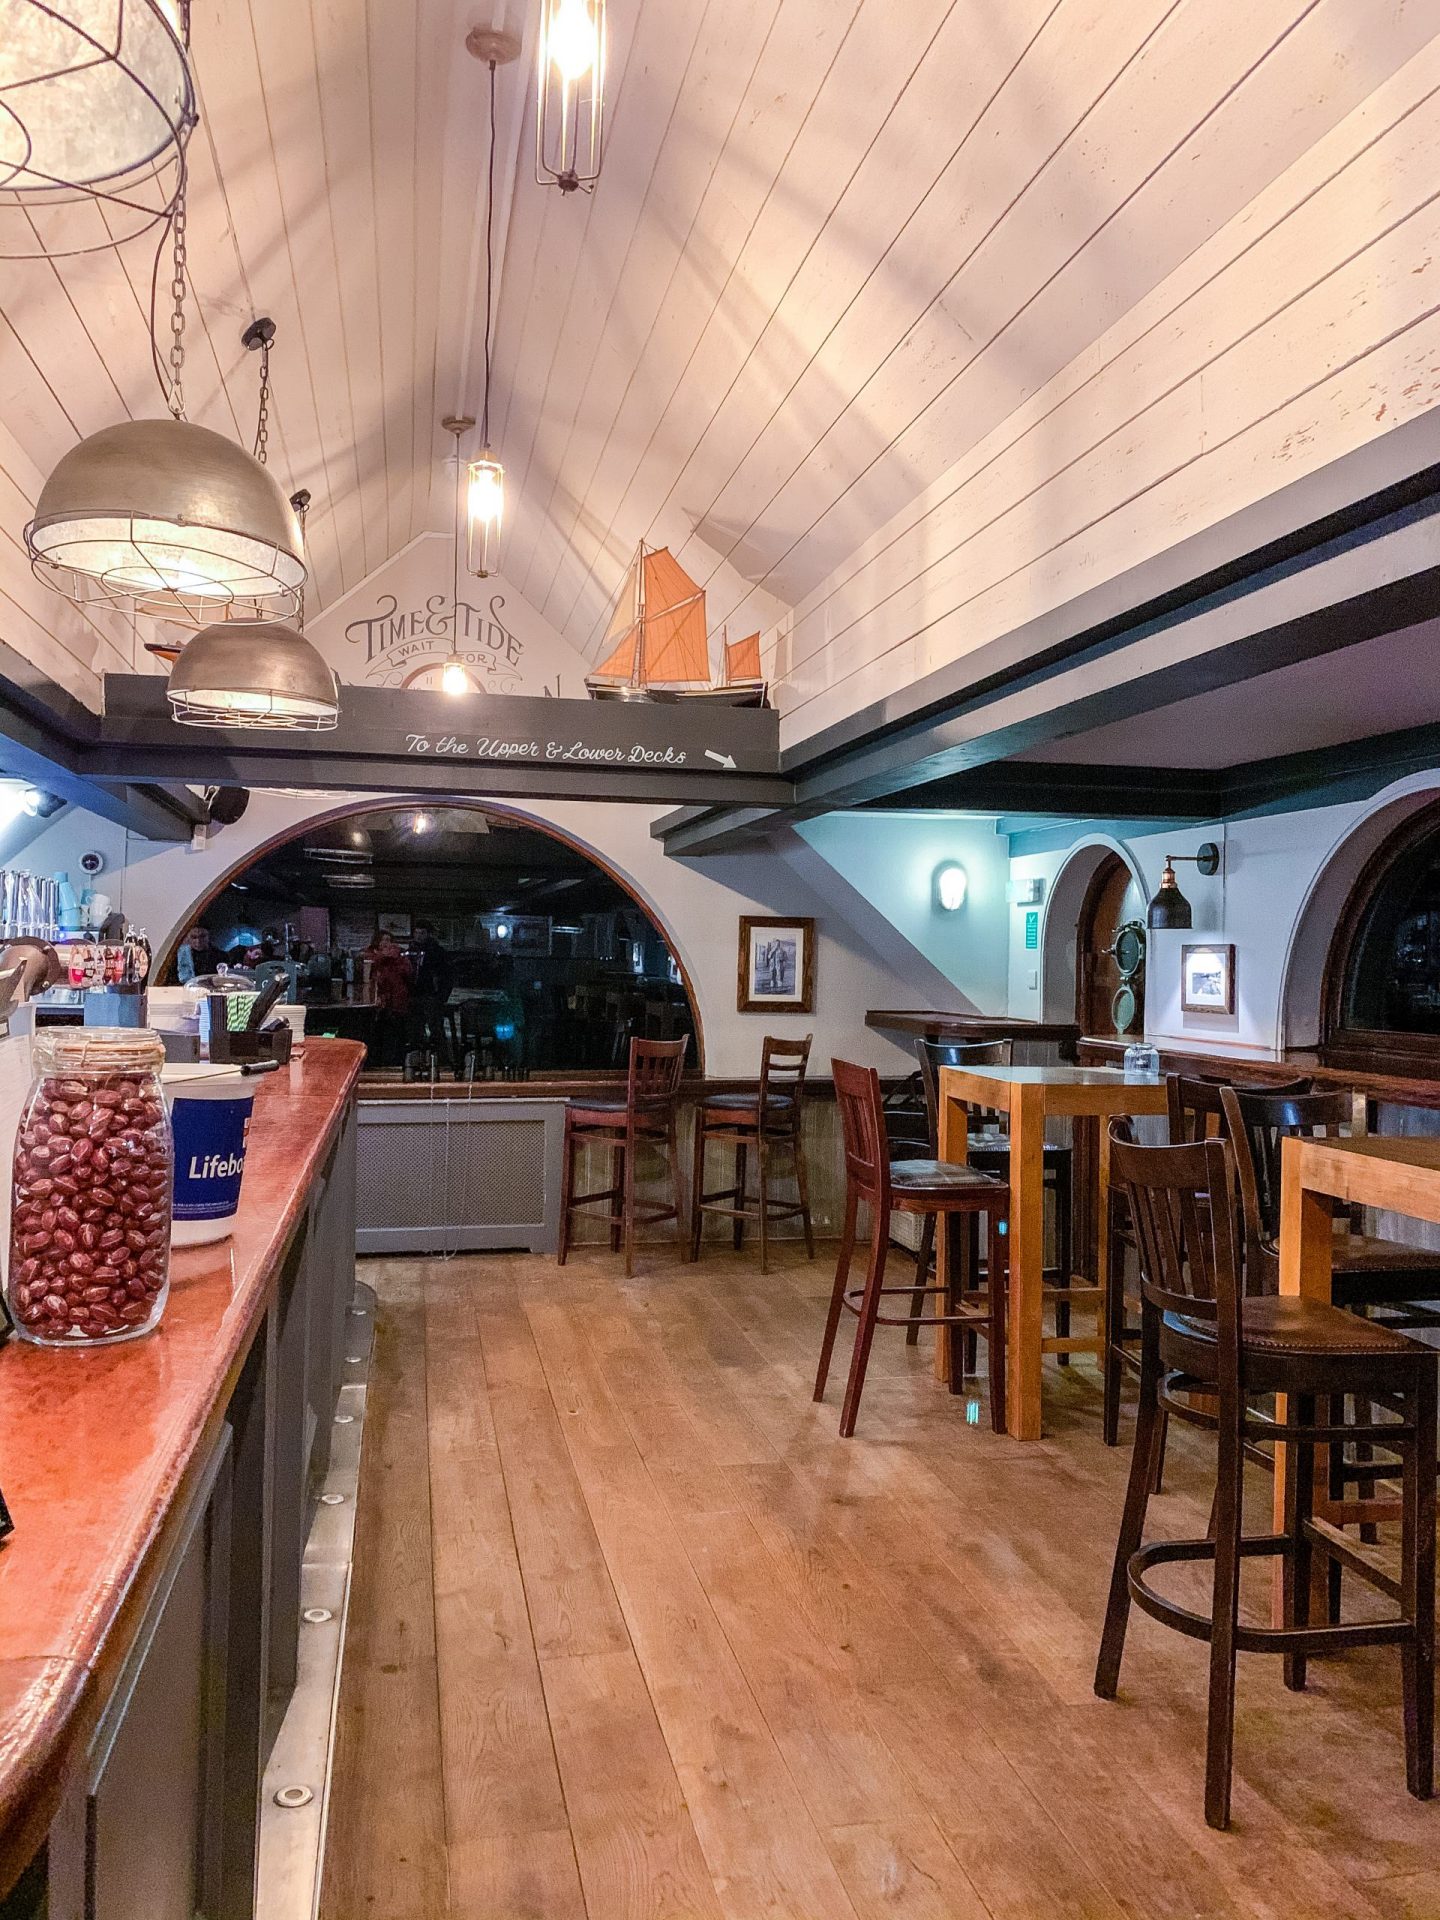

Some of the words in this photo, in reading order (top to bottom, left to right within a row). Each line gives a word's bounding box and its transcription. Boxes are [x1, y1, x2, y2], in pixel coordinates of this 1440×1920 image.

[345, 594, 425, 665] TIME
[425, 595, 456, 635] &
[452, 595, 525, 666] TIDE
[400, 640, 434, 656] WAIT
[405, 734, 430, 752] To
[435, 736, 469, 754] the
[476, 737, 540, 758] Upper
[545, 741, 563, 758] &
[562, 741, 625, 761] Lower
[627, 746, 687, 764] Decks
